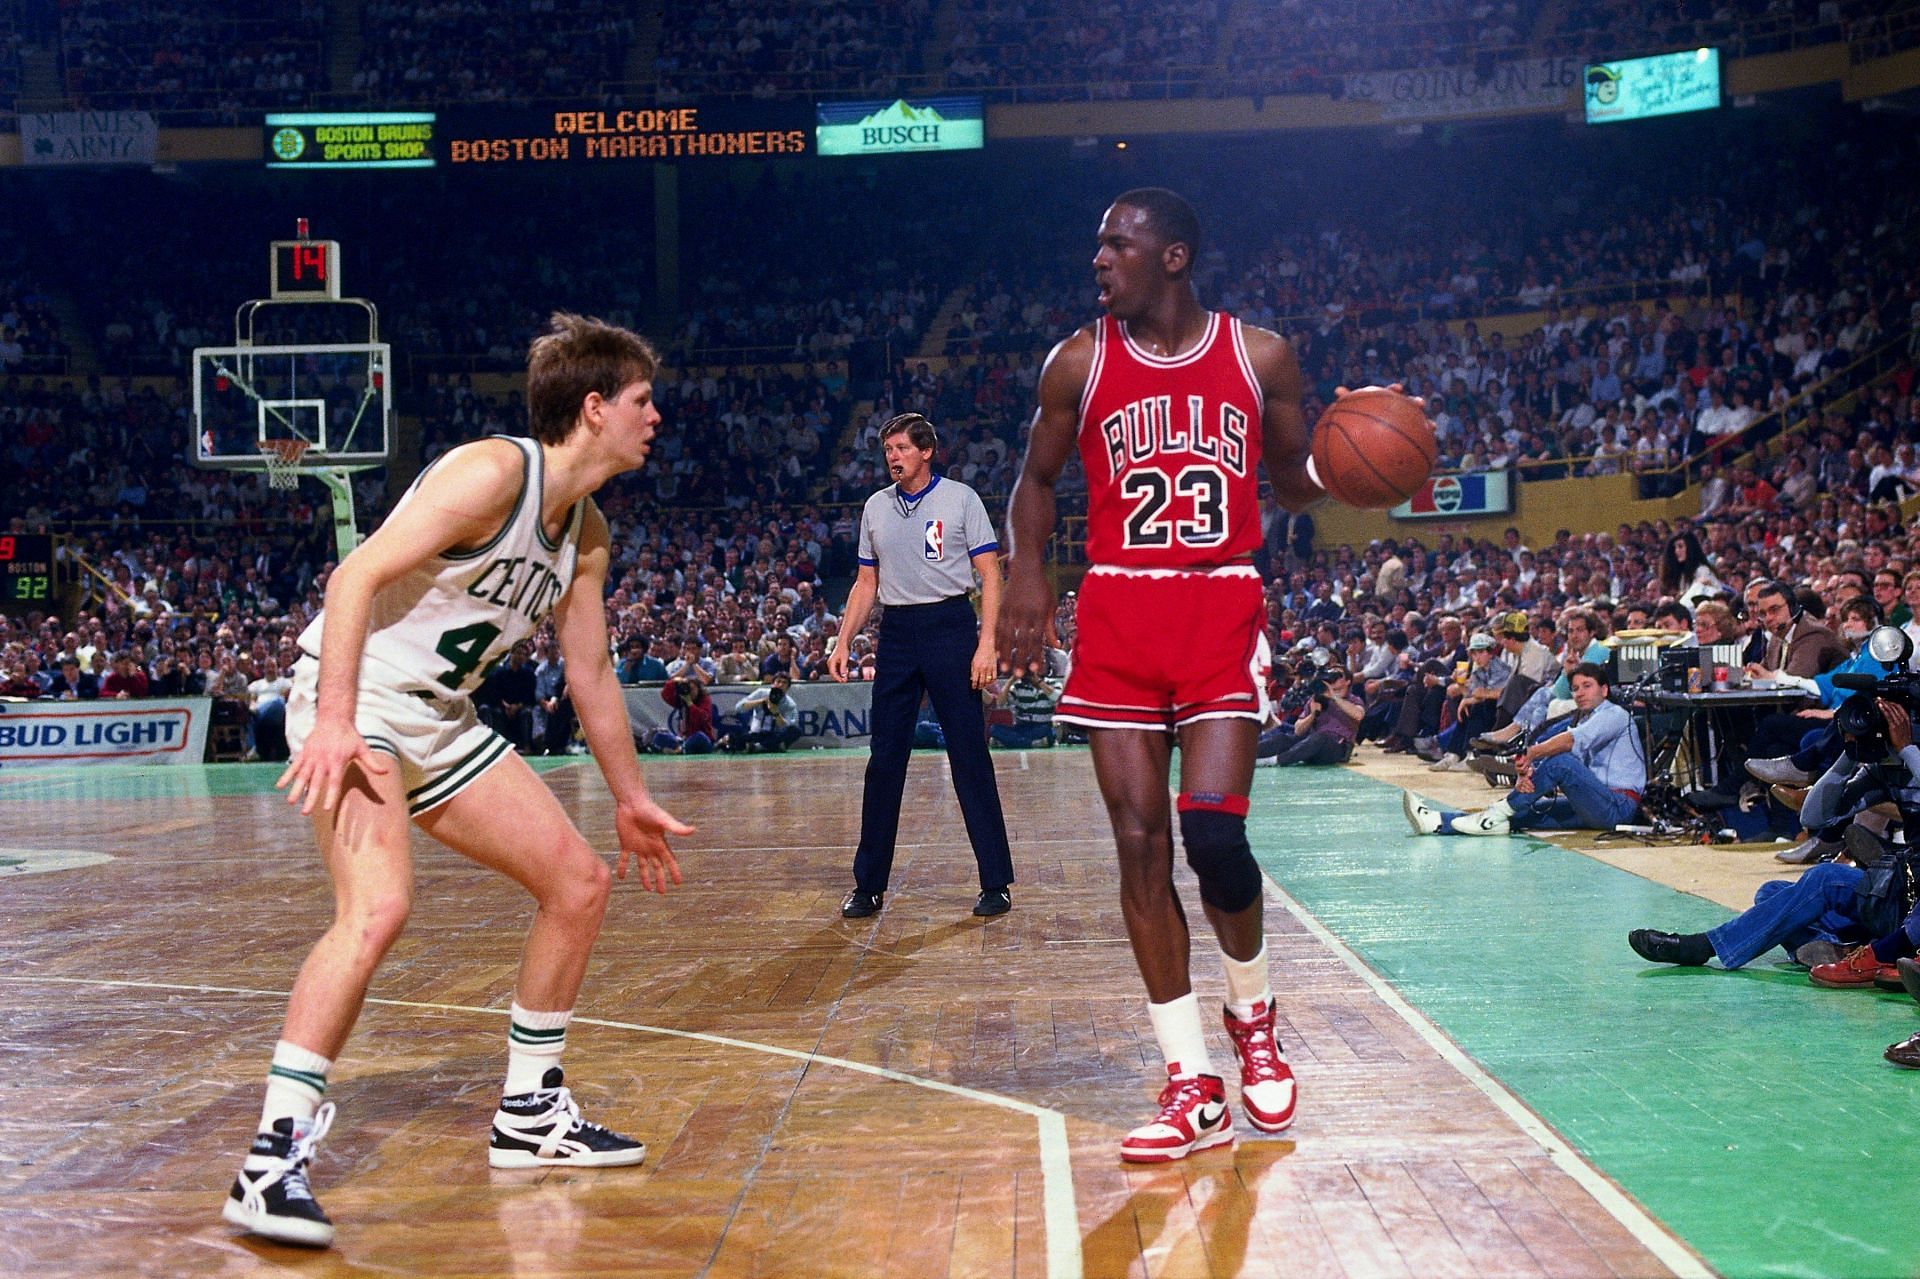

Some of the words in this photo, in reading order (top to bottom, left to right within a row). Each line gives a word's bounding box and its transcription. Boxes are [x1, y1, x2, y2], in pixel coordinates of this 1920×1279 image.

[1393, 67, 1477, 101] GOING
[1494, 61, 1528, 94] ON
[1541, 57, 1577, 88] 16
[316, 127, 373, 143] BOSTON
[377, 124, 432, 141] BRUINS
[554, 109, 698, 134] WELCOME
[451, 138, 569, 162] BOSTON
[586, 131, 805, 158] MARATHONERS
[862, 124, 941, 145] BUSCH
[60, 137, 133, 159] ARMY
[324, 143, 381, 160] SPORTS
[385, 142, 424, 158] SHOP
[293, 243, 325, 280] 14
[1101, 395, 1248, 484] BULLS
[1121, 465, 1229, 549] 23
[1434, 489, 1461, 501] PEPSI
[8, 562, 46, 574] BOSTON
[16, 577, 47, 599] 92
[467, 557, 562, 622] CETICS
[0, 726, 66, 747] BUD
[75, 721, 180, 746] LIGHT
[798, 709, 873, 739] BAN
